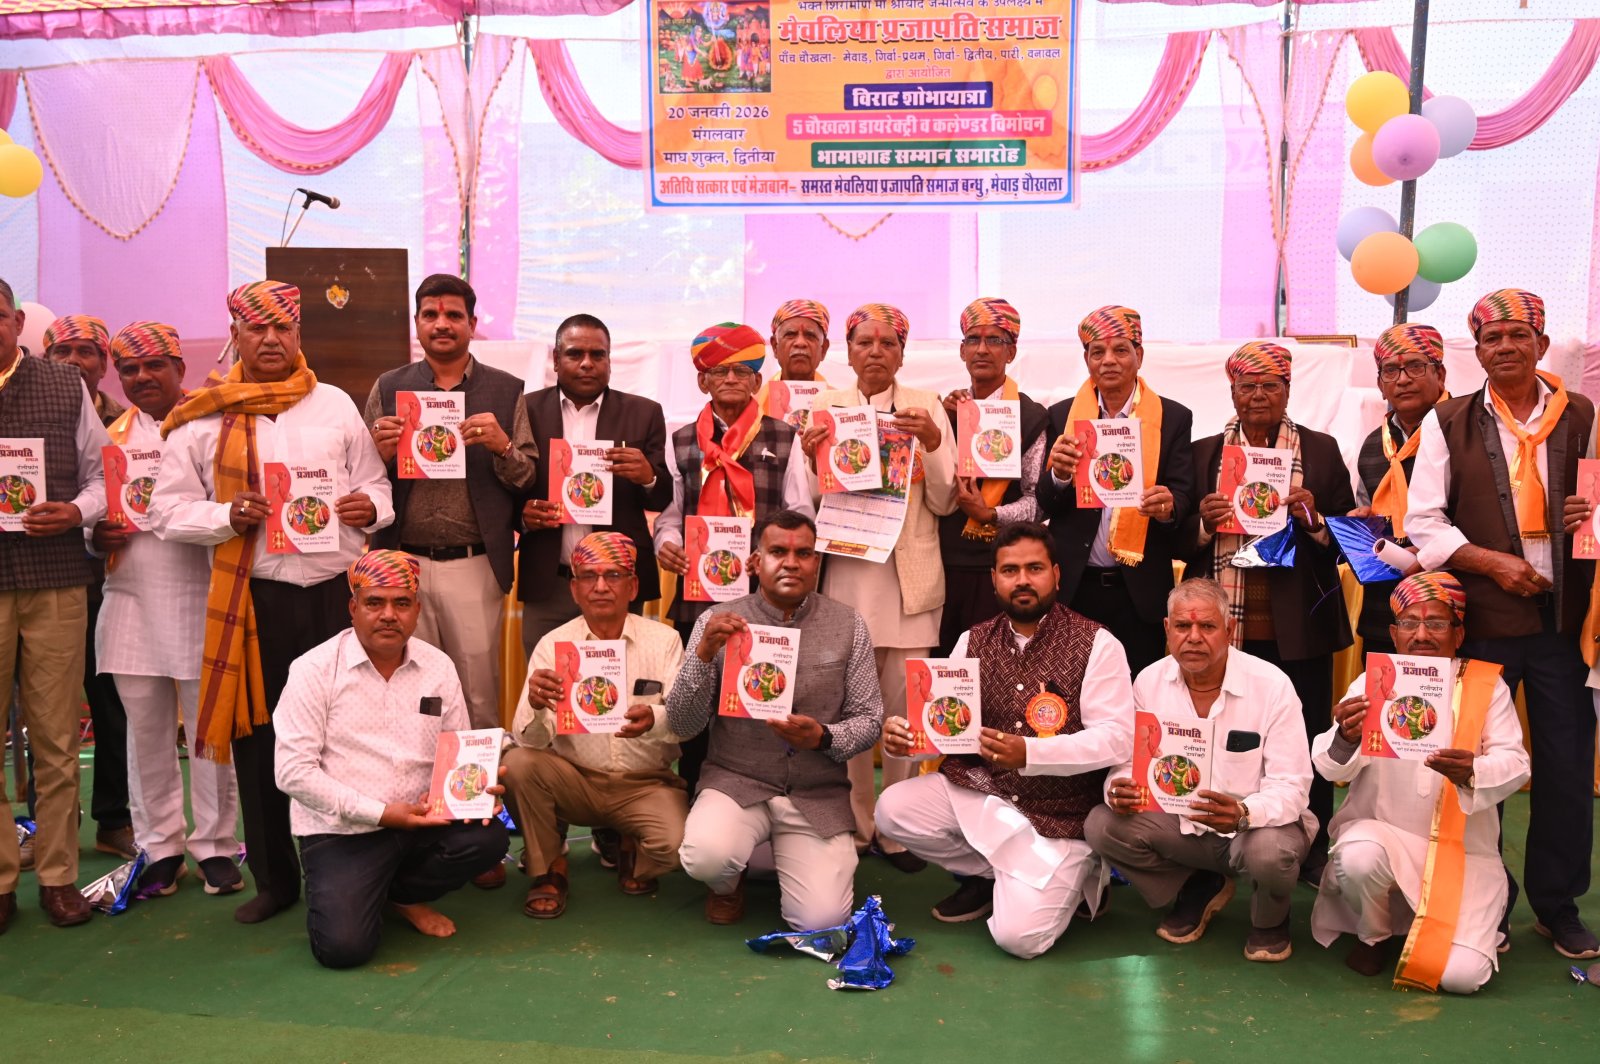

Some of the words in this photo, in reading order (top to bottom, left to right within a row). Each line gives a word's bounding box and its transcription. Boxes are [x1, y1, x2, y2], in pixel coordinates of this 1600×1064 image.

[778, 15, 878, 43] मेवलिया
[882, 12, 981, 43] प्रजापति
[984, 16, 1061, 40] समाज
[885, 68, 904, 80] द्वारा
[908, 66, 951, 78] आयोजित
[852, 88, 900, 106] विराट
[902, 86, 987, 106] शोभायात्रा
[668, 108, 684, 118] 20
[688, 102, 730, 118] जनवरी
[735, 106, 769, 118] 2026
[792, 120, 803, 135] 5
[805, 115, 856, 135] चौखला
[858, 114, 917, 137] डायरेक्ट्री
[920, 118, 931, 134] व
[933, 114, 989, 134] कलेण्डर
[990, 113, 1046, 132] विमोचन
[692, 126, 745, 140] मंगलवार
[663, 152, 688, 163] माघ
[733, 148, 776, 164] द्वितीया
[817, 150, 892, 164] भामाशाह
[894, 148, 952, 164] सम्मान
[954, 144, 1020, 163] समारोह
[660, 176, 694, 194] अतिथि
[696, 180, 729, 194] सत्कार
[732, 176, 748, 194] एवं
[800, 179, 832, 194] समस्त
[834, 174, 878, 194] मेवलिया
[880, 174, 924, 194] प्रजापति
[926, 178, 960, 193] समाज
[991, 173, 1020, 196] मेवाड़
[1022, 172, 1063, 192] चौखला
[426, 400, 455, 408] प्रजापति
[1102, 426, 1130, 436] प्रजापति
[0, 448, 33, 457] प्रजापति
[132, 450, 161, 460] प्रजापति
[1252, 457, 1282, 466] प्रजापति
[296, 469, 328, 478] प्रजापति
[714, 525, 742, 533] प्रजापति
[759, 635, 790, 646] प्रजापति
[586, 648, 616, 658] प्रजापति
[937, 668, 968, 678] प्रजापति
[1402, 666, 1438, 677] प्रजापति
[1168, 727, 1202, 738] प्रजापति
